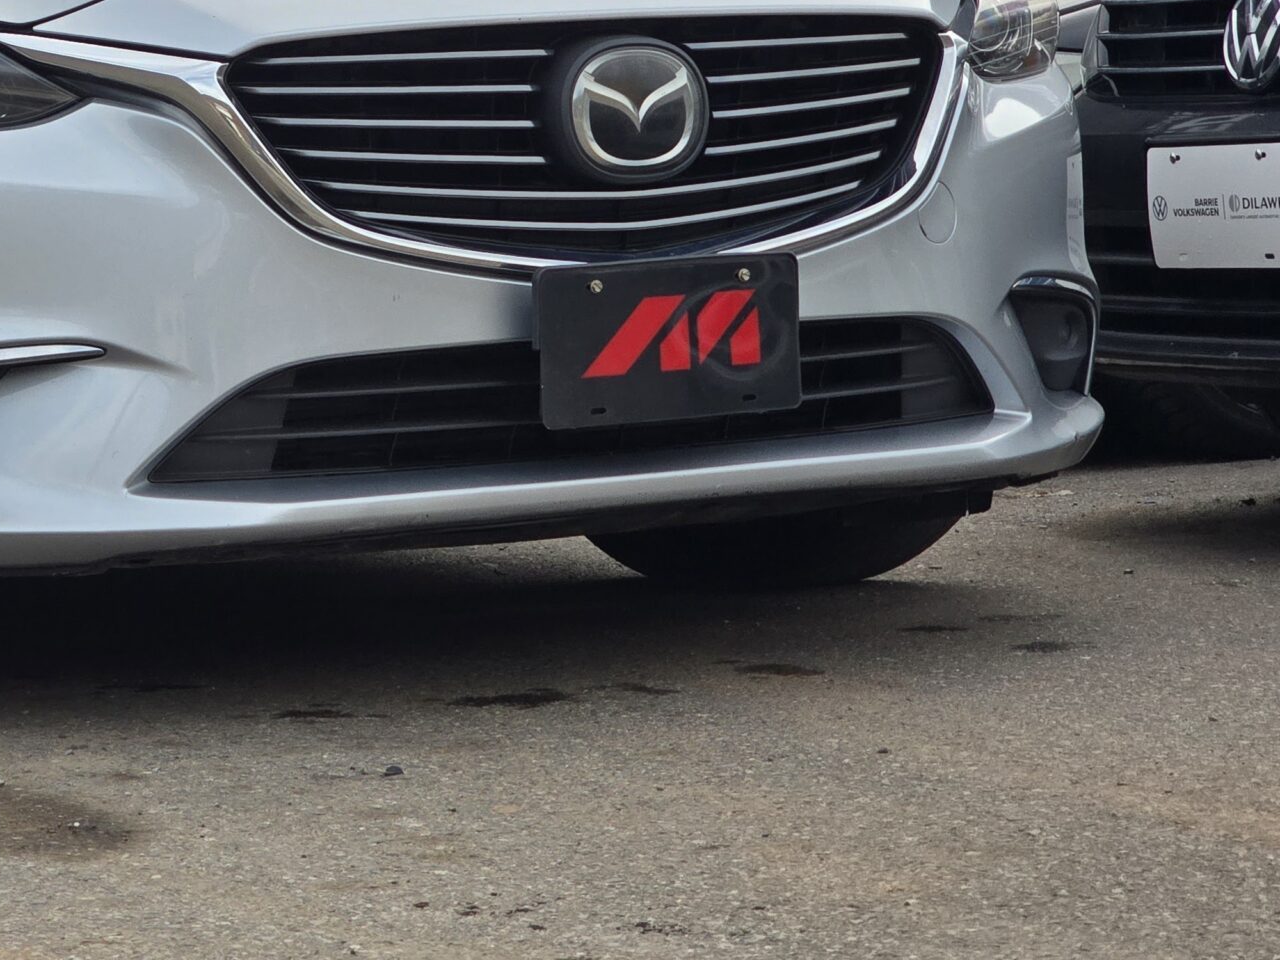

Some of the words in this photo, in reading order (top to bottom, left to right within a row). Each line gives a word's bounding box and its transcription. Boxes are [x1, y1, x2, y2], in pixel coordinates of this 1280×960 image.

[1194, 197, 1219, 207] BARRIE
[1241, 196, 1280, 209] DILAW
[1173, 207, 1220, 217] VOLKSWAGEN
